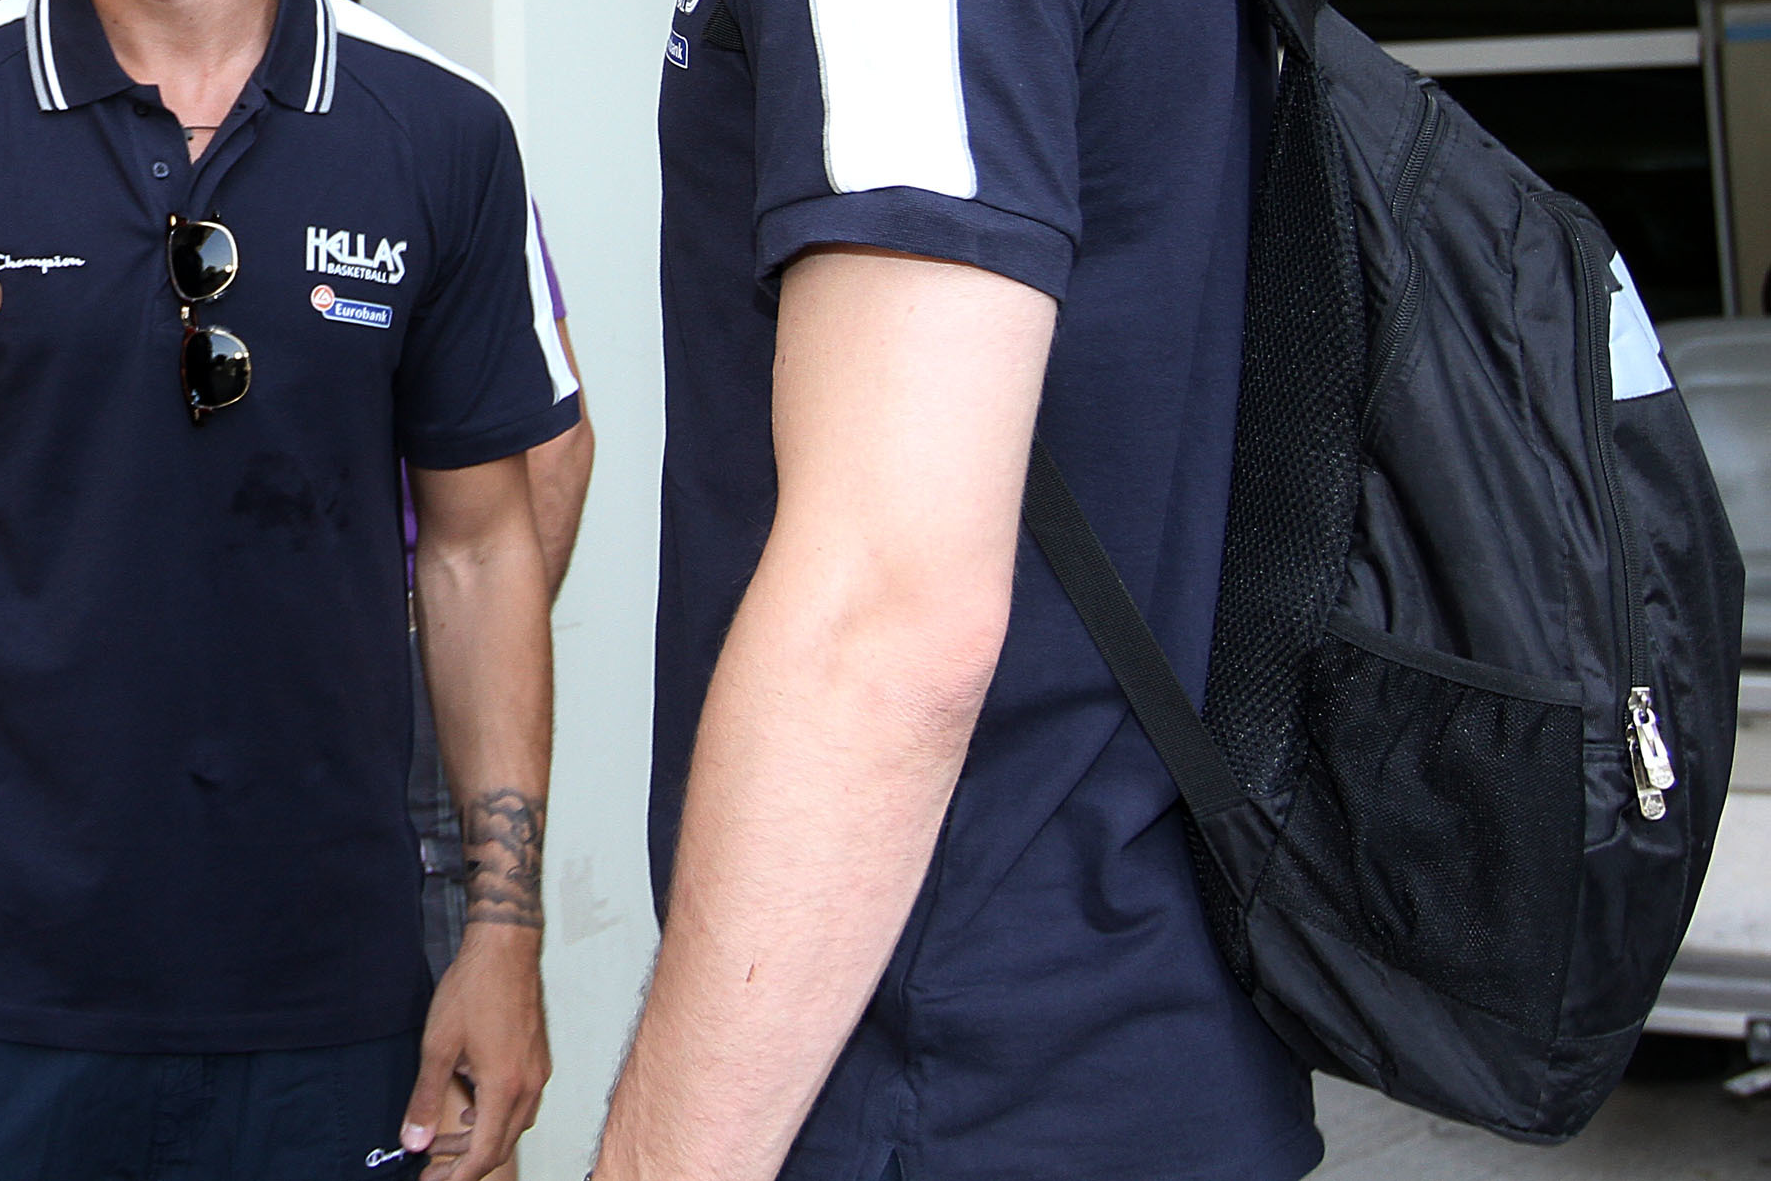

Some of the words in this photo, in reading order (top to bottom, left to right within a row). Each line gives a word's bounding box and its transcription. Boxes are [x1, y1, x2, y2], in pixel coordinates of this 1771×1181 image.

[306, 226, 407, 285] HELLAS
[327, 262, 387, 283] BASKETBALL
[334, 303, 388, 322] Eurobank
